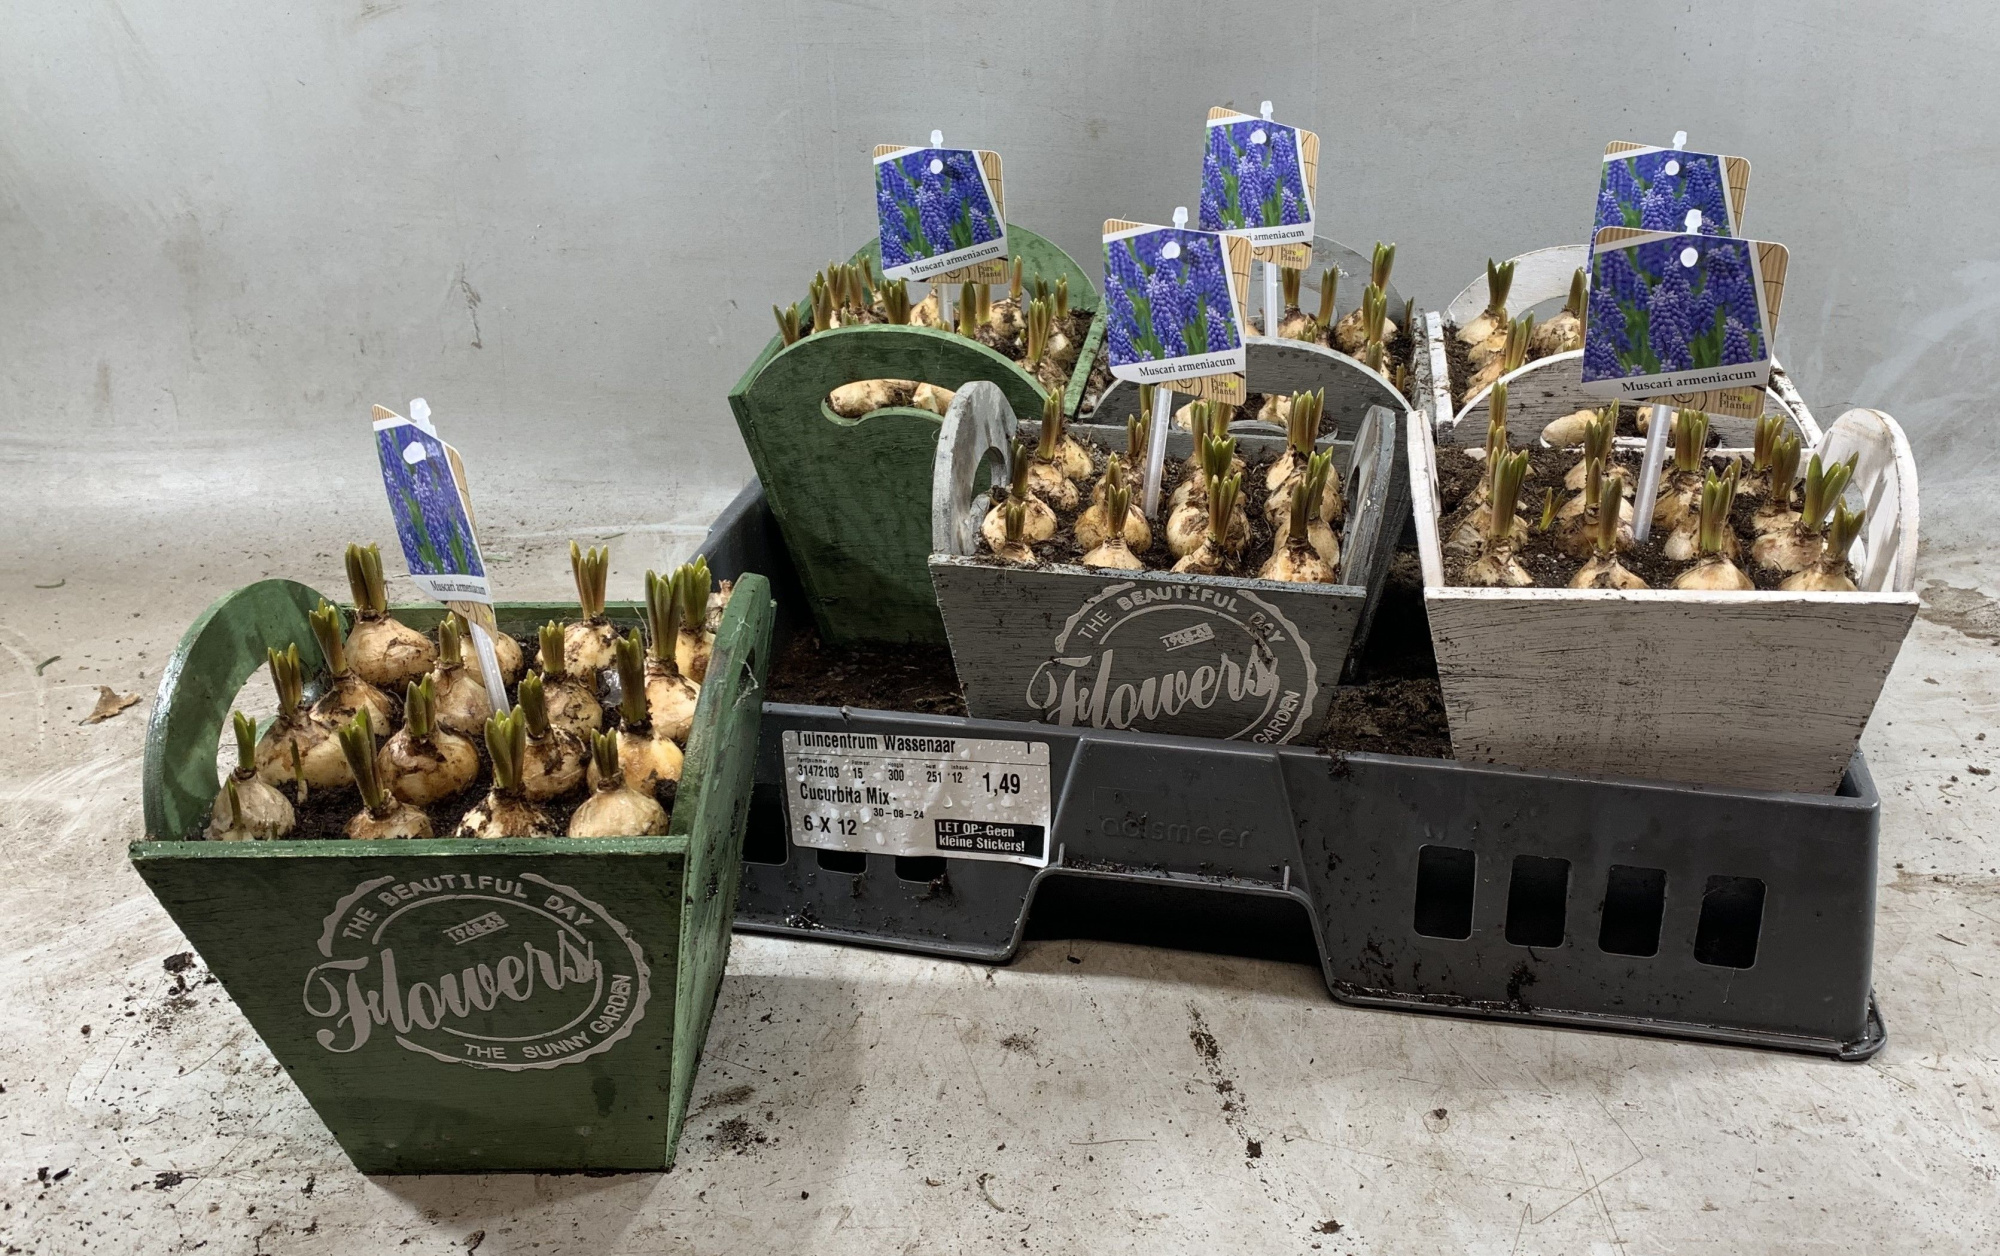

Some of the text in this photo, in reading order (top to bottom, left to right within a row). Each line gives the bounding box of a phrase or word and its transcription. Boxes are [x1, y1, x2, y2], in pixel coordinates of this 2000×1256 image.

[1253, 230, 1305, 241] armeniacum
[909, 245, 1000, 275] Muscari armeniacum
[1139, 356, 1236, 377] Muscari armeniacum
[1211, 378, 1229, 388] Pure
[1211, 386, 1236, 396] Plants
[1621, 369, 1757, 392] Muscari armeniacum
[1719, 391, 1743, 402] Pure
[1719, 400, 1752, 410] Plants
[430, 580, 456, 591] Muscari
[1077, 584, 1286, 643] THE BEAUTIFUL DAY
[1026, 644, 1278, 731] Flowers
[1252, 689, 1301, 744] GARDEN
[796, 731, 878, 751] Tuincentrum
[884, 735, 956, 755] Wassenaar
[797, 764, 1021, 796] 31472103 15 300 251 12 1,49
[799, 783, 891, 805] Cucurbita Mix
[803, 814, 813, 831] 6
[838, 819, 858, 836] 12
[938, 821, 1015, 838] LET OP: Geen
[939, 835, 1025, 852] kleine Stickers!
[342, 874, 594, 940] THE BEAUTIFUL DAY
[303, 930, 595, 1053] Flowers
[464, 974, 633, 1060] THE SUNNY GARDEN
